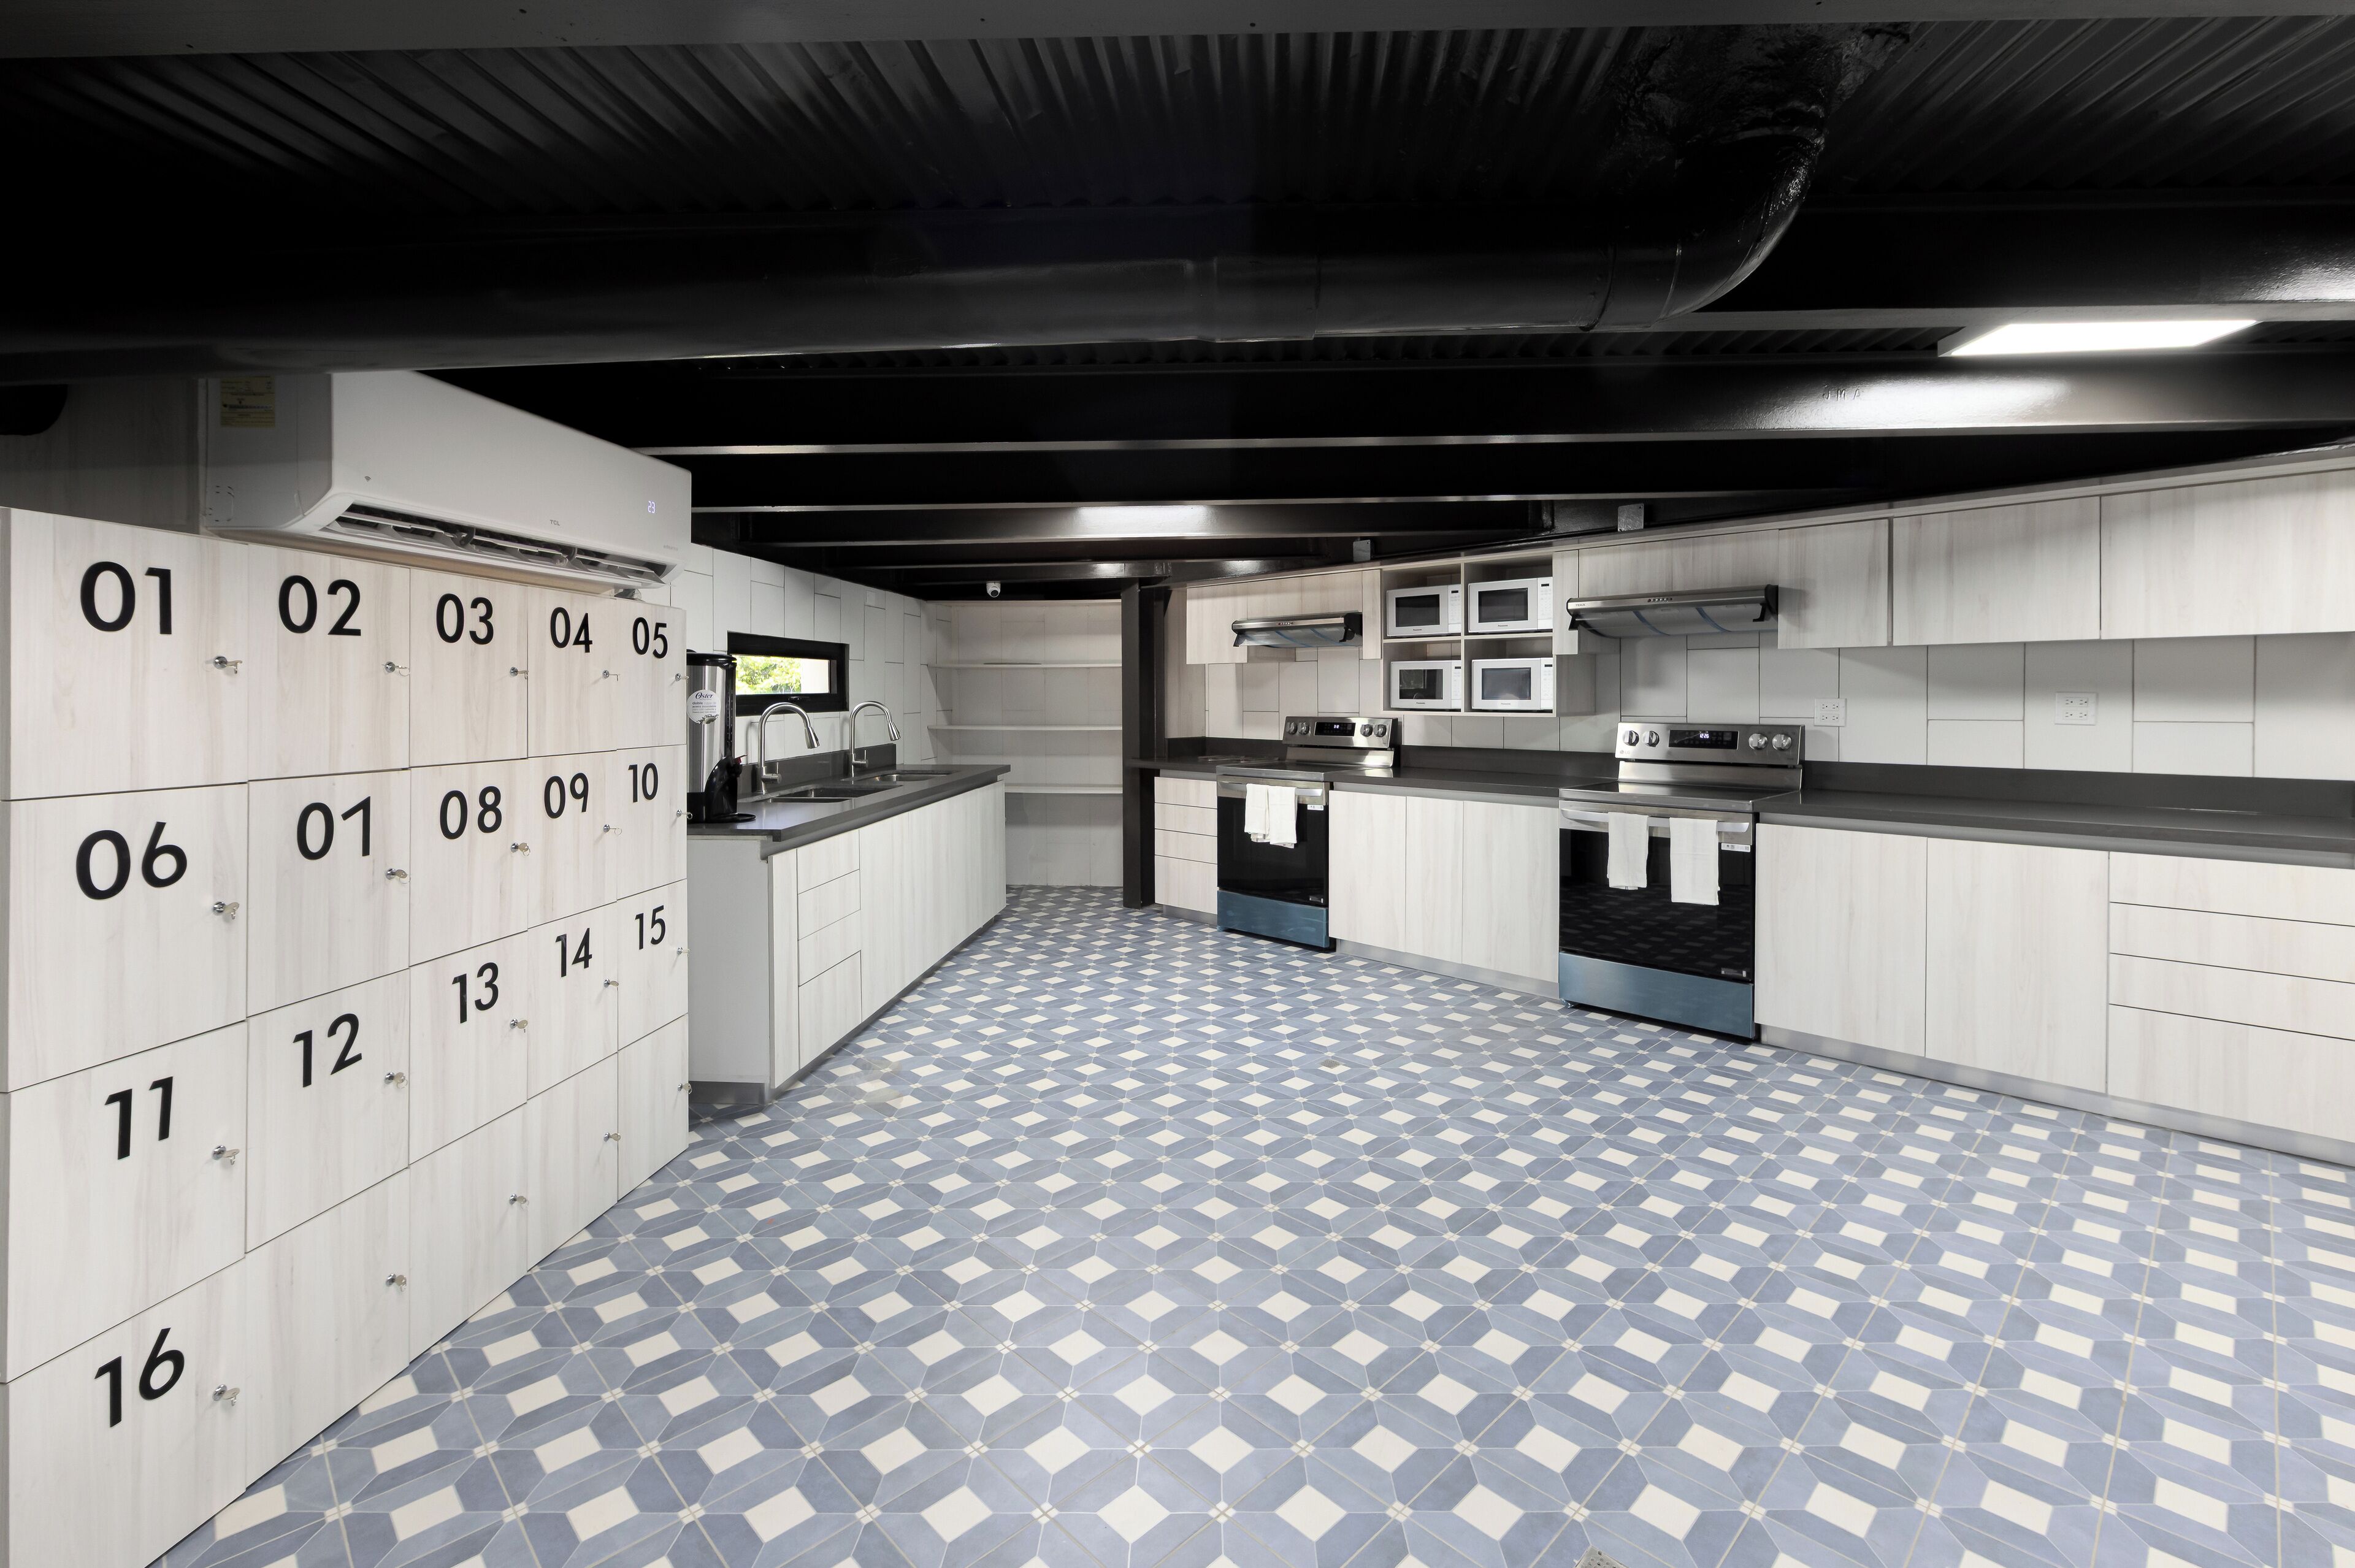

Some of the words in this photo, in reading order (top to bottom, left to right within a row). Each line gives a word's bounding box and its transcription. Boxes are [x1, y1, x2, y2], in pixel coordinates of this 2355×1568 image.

[648, 500, 655, 513] 23
[81, 562, 171, 634] 01
[279, 575, 361, 636] 02
[437, 594, 493, 644] 03
[551, 607, 592, 652] 04
[633, 618, 667, 659] 05
[545, 773, 588, 818] 09
[629, 763, 658, 802] 10
[440, 786, 502, 839] 08
[77, 822, 186, 900] 06
[556, 928, 592, 977] 14
[635, 906, 665, 949] 15
[453, 963, 498, 1023] 13
[293, 1014, 362, 1087] 12
[105, 1077, 172, 1160] 11
[95, 1328, 184, 1427] 16
